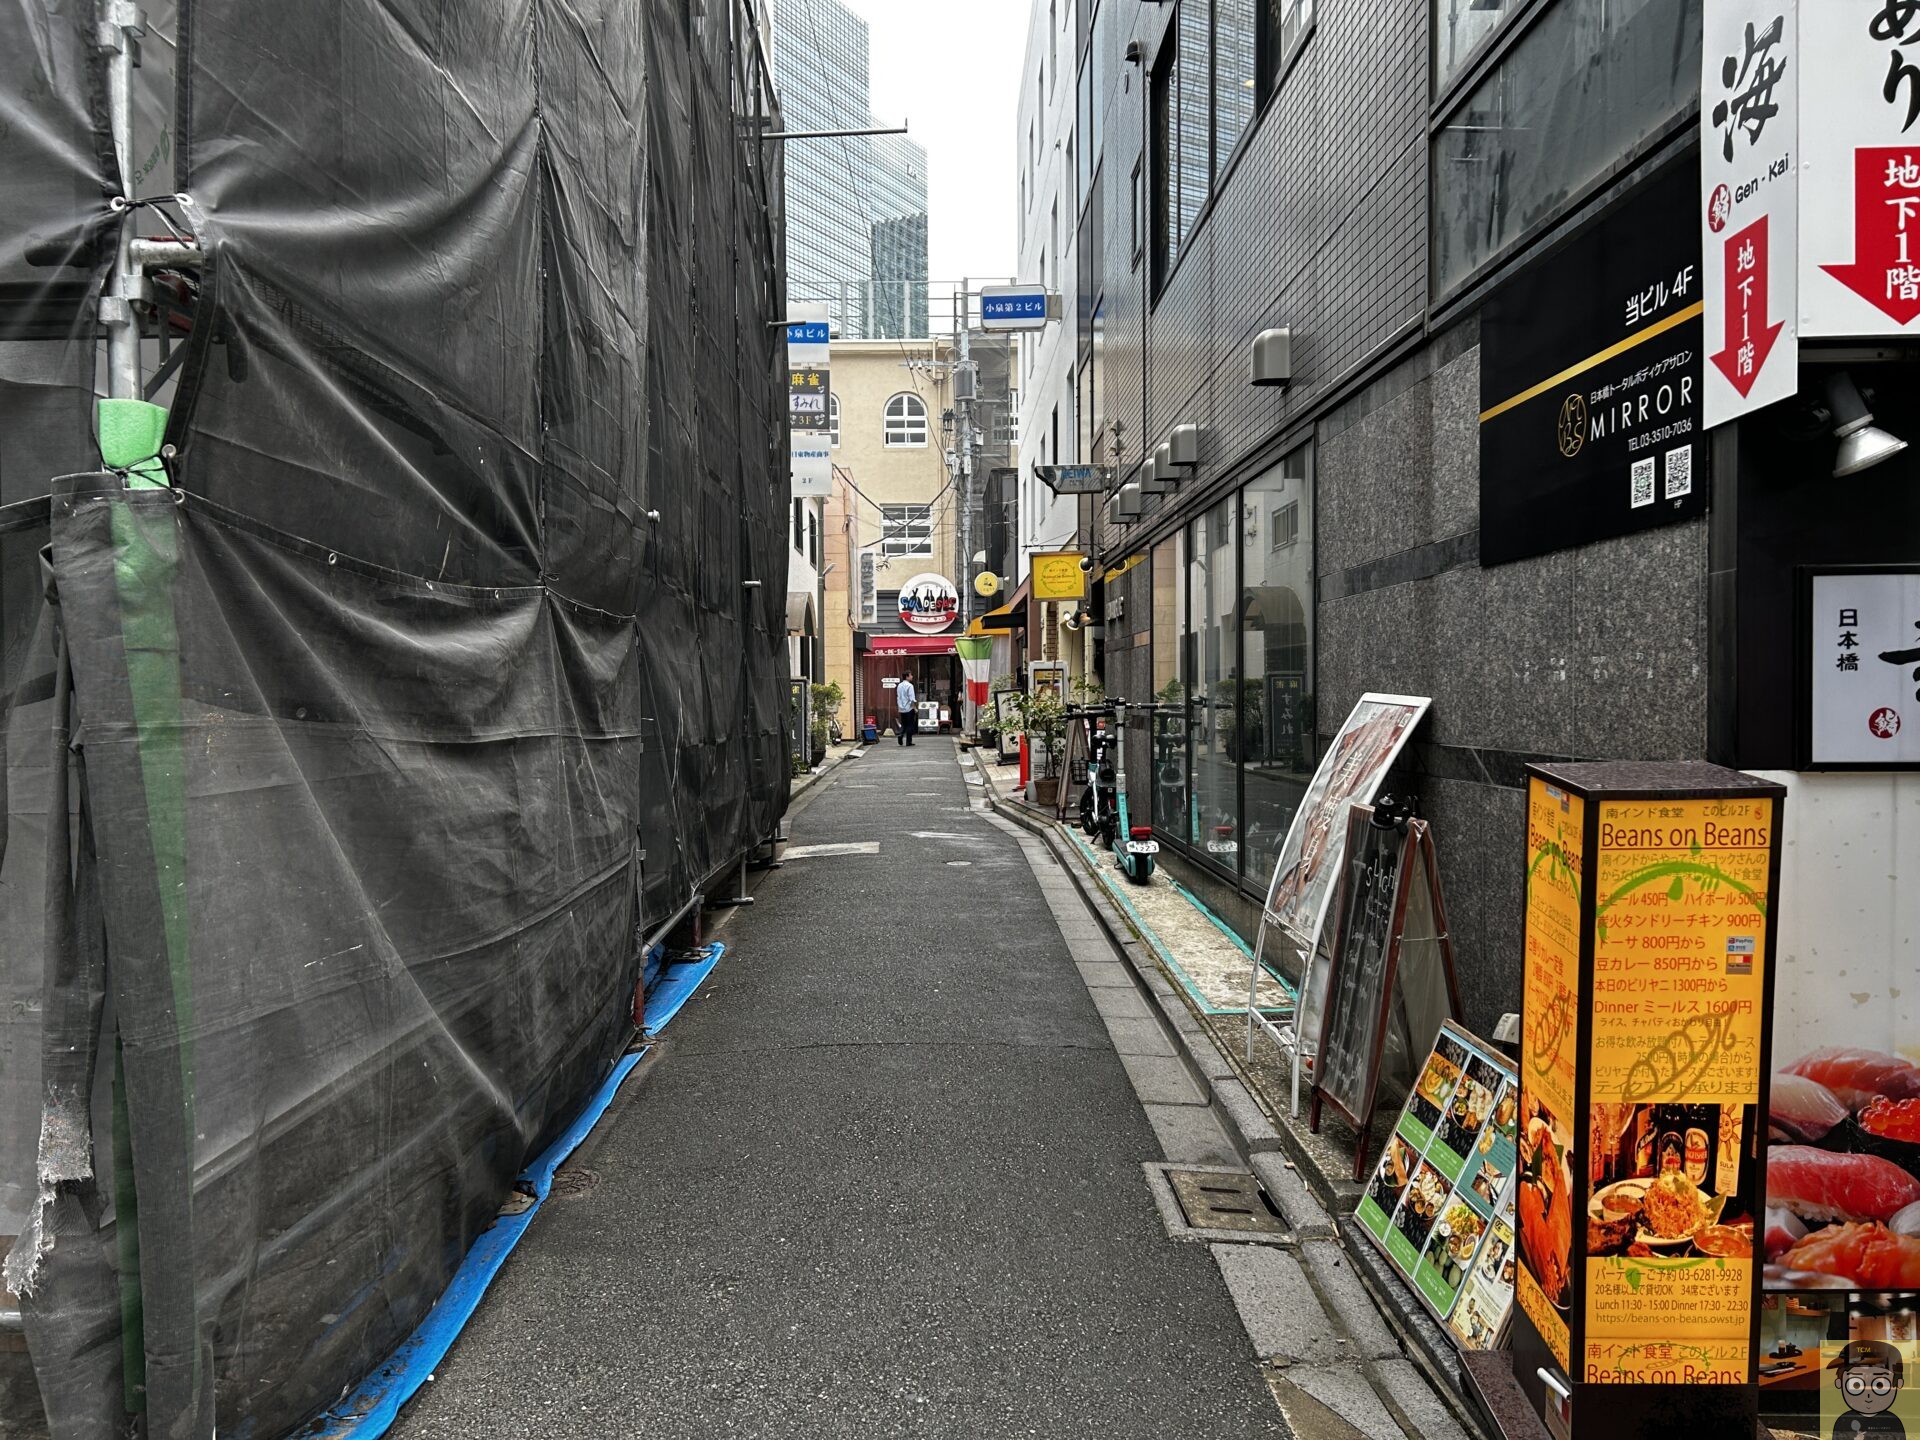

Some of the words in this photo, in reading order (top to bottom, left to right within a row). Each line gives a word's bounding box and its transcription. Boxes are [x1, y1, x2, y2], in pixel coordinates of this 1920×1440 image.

[1713, 15, 1788, 164] 海
[1735, 177, 1759, 204] Gen
[1768, 152, 1789, 183] Kai
[1626, 281, 1669, 326] 当ビル
[1672, 265, 1693, 298] 4F
[1736, 244, 1755, 378] 地下1階
[791, 373, 820, 386] 麻雀
[1590, 351, 1693, 404] 日本橋トータルボディケアサロン
[792, 395, 821, 410] すみれ
[1590, 376, 1692, 441] MIRROR
[798, 416, 812, 425] 3F
[1836, 608, 1860, 672] 日本橋
[1606, 807, 1684, 819] 南インド食堂
[1602, 823, 1663, 847] Beans
[1669, 828, 1697, 847] on
[1704, 822, 1767, 846] Beans
[1640, 891, 1668, 907] 450円
[1684, 891, 1736, 907] ハイボール
[1727, 913, 1762, 929] 900円
[1642, 935, 1706, 950] 800円から
[1596, 957, 1650, 972] 豆カレー
[1653, 956, 1718, 971] 850円から
[1595, 978, 1670, 993] 本日のビリヤニ
[1673, 978, 1728, 993] 1300円から
[1594, 1000, 1639, 1014] Dinner
[1643, 1000, 1700, 1014] ミールス
[1720, 1161, 1734, 1169] SULA
[1679, 1269, 1742, 1282] 03-6281-9928
[1681, 1285, 1740, 1296] 34席ございます
[1595, 1300, 1619, 1311] Lunch
[1622, 1300, 1642, 1311] 11:30
[1650, 1300, 1669, 1311] 15:00
[1671, 1300, 1697, 1311] Dinner
[1700, 1301, 1720, 1311] 17:30
[1727, 1301, 1748, 1311] 22:30
[1588, 1344, 1673, 1360] 南インド食堂
[1587, 1364, 1645, 1384] Beans
[1651, 1369, 1676, 1384] on
[1684, 1365, 1741, 1384] Beans
